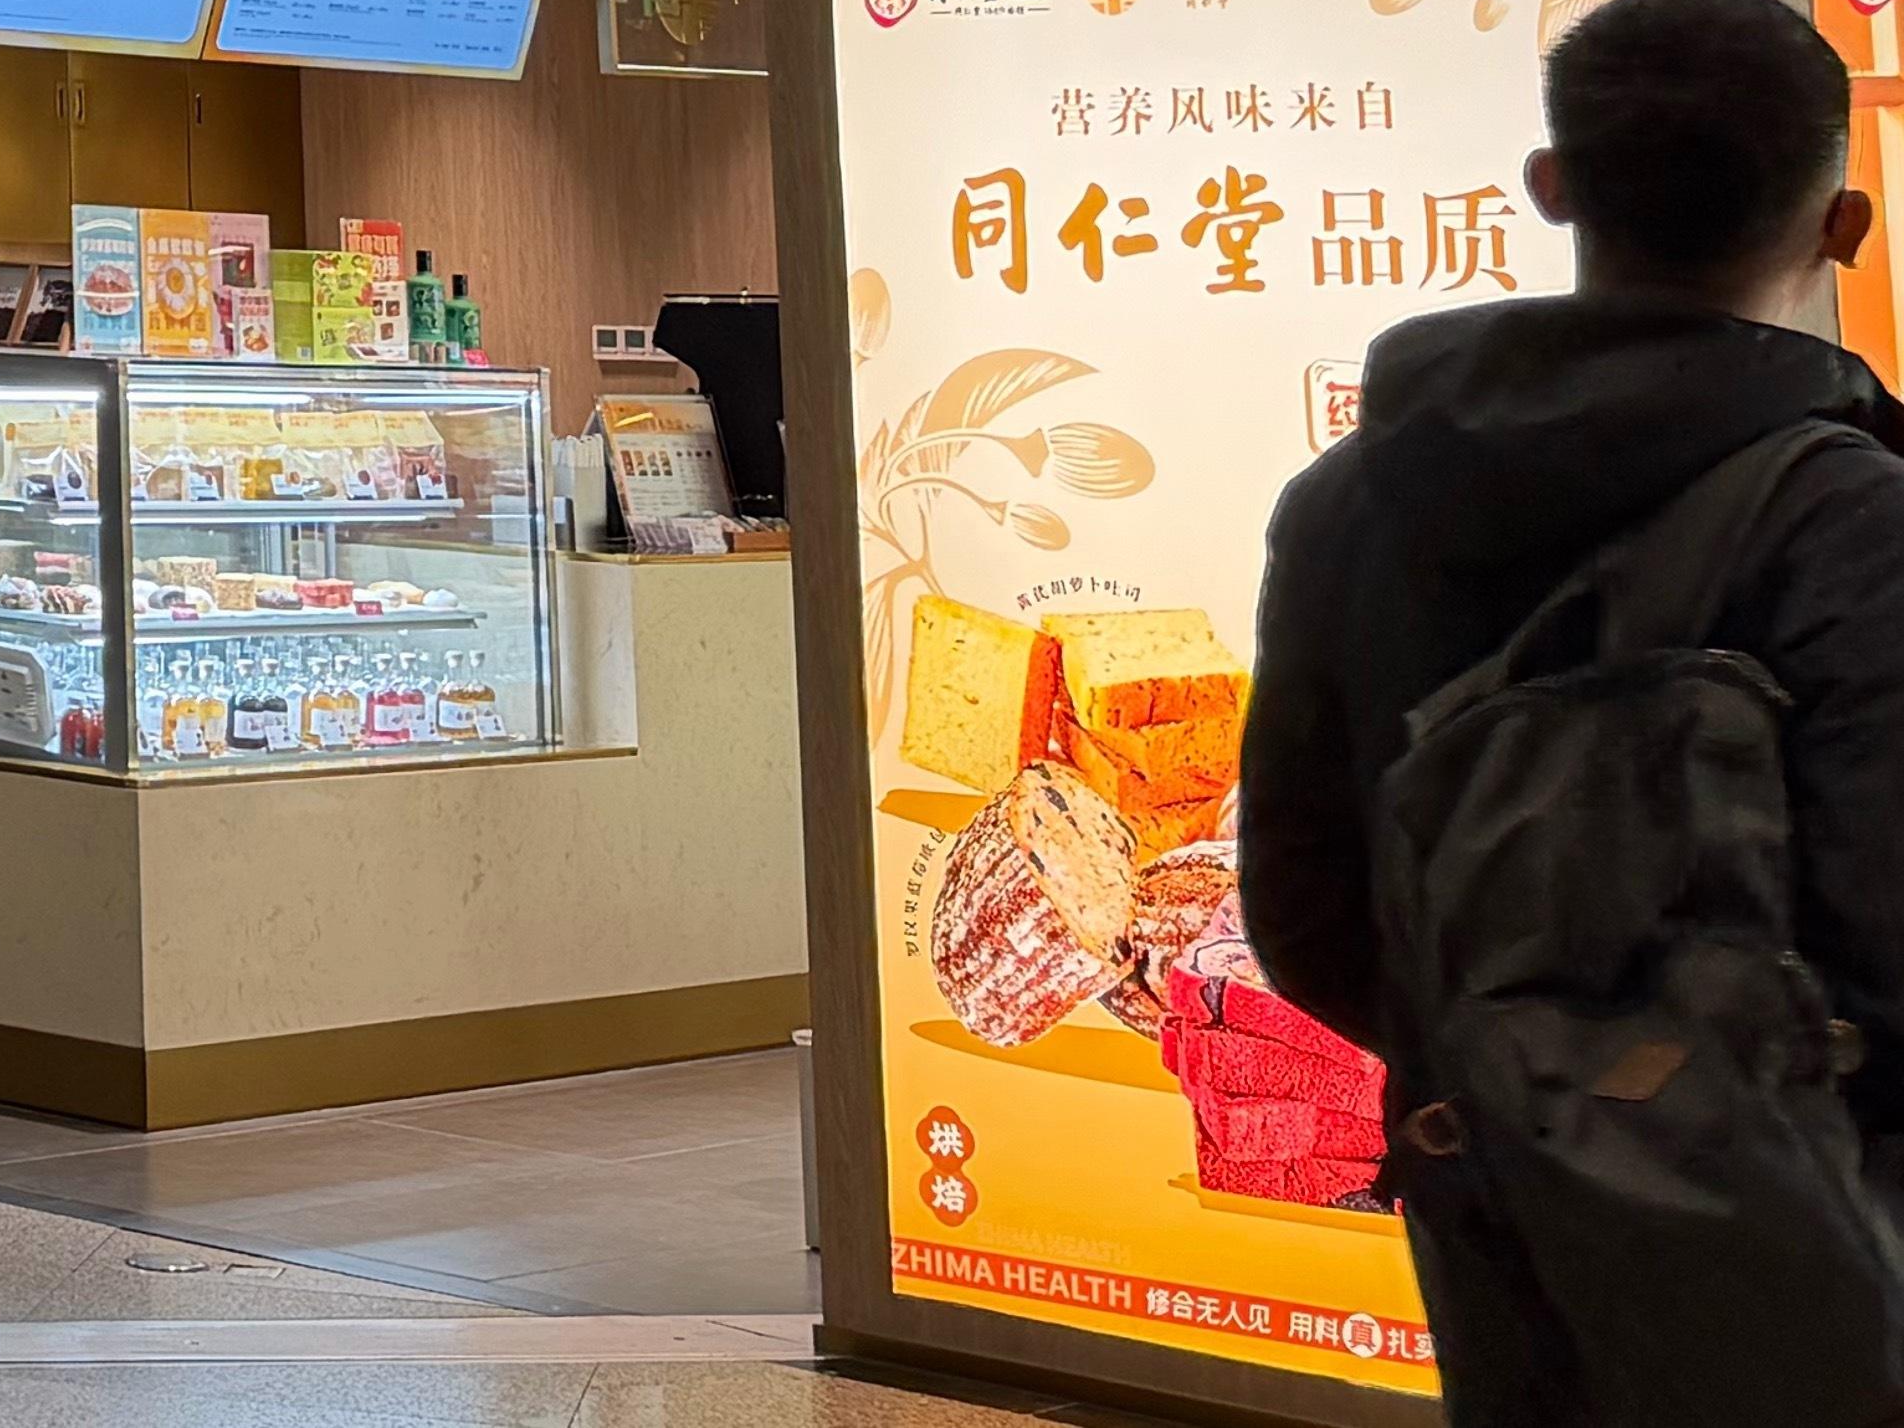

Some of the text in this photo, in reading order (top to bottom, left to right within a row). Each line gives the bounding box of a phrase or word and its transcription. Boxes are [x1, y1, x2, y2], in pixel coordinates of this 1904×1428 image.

[1051, 80, 1396, 137] 营养风味来自
[927, 1122, 967, 1213] 烘焙
[892, 1242, 1132, 1309] ZHIMA HEALTH
[1145, 1288, 1272, 1334] 修合无人见
